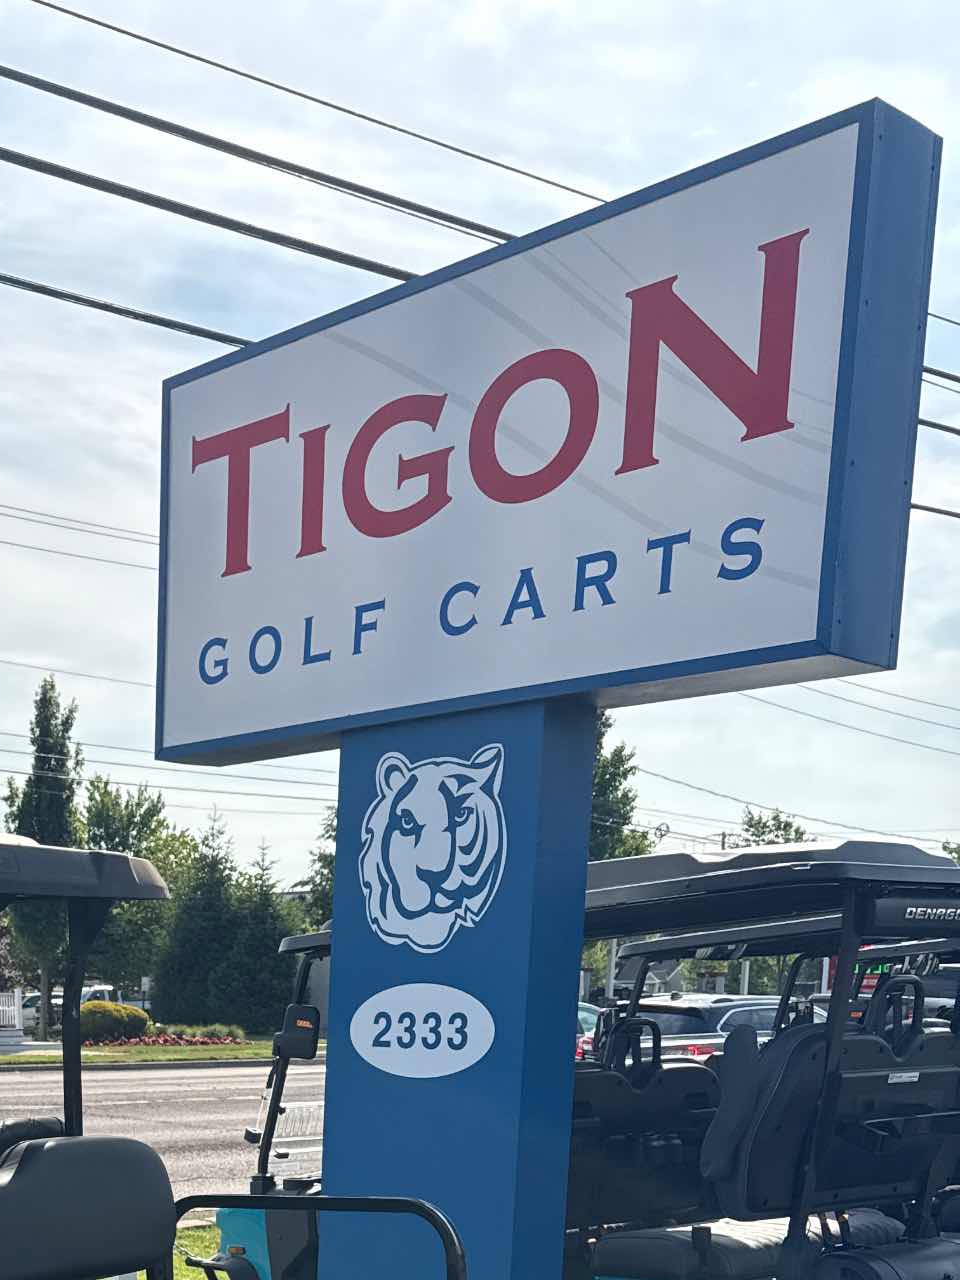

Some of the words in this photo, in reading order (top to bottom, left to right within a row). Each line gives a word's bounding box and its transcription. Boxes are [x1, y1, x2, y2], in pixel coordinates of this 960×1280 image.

[191, 228, 810, 578] TIGON
[198, 600, 386, 685] GOLF
[439, 517, 766, 636] CARTS
[372, 1011, 468, 1050] 2333
